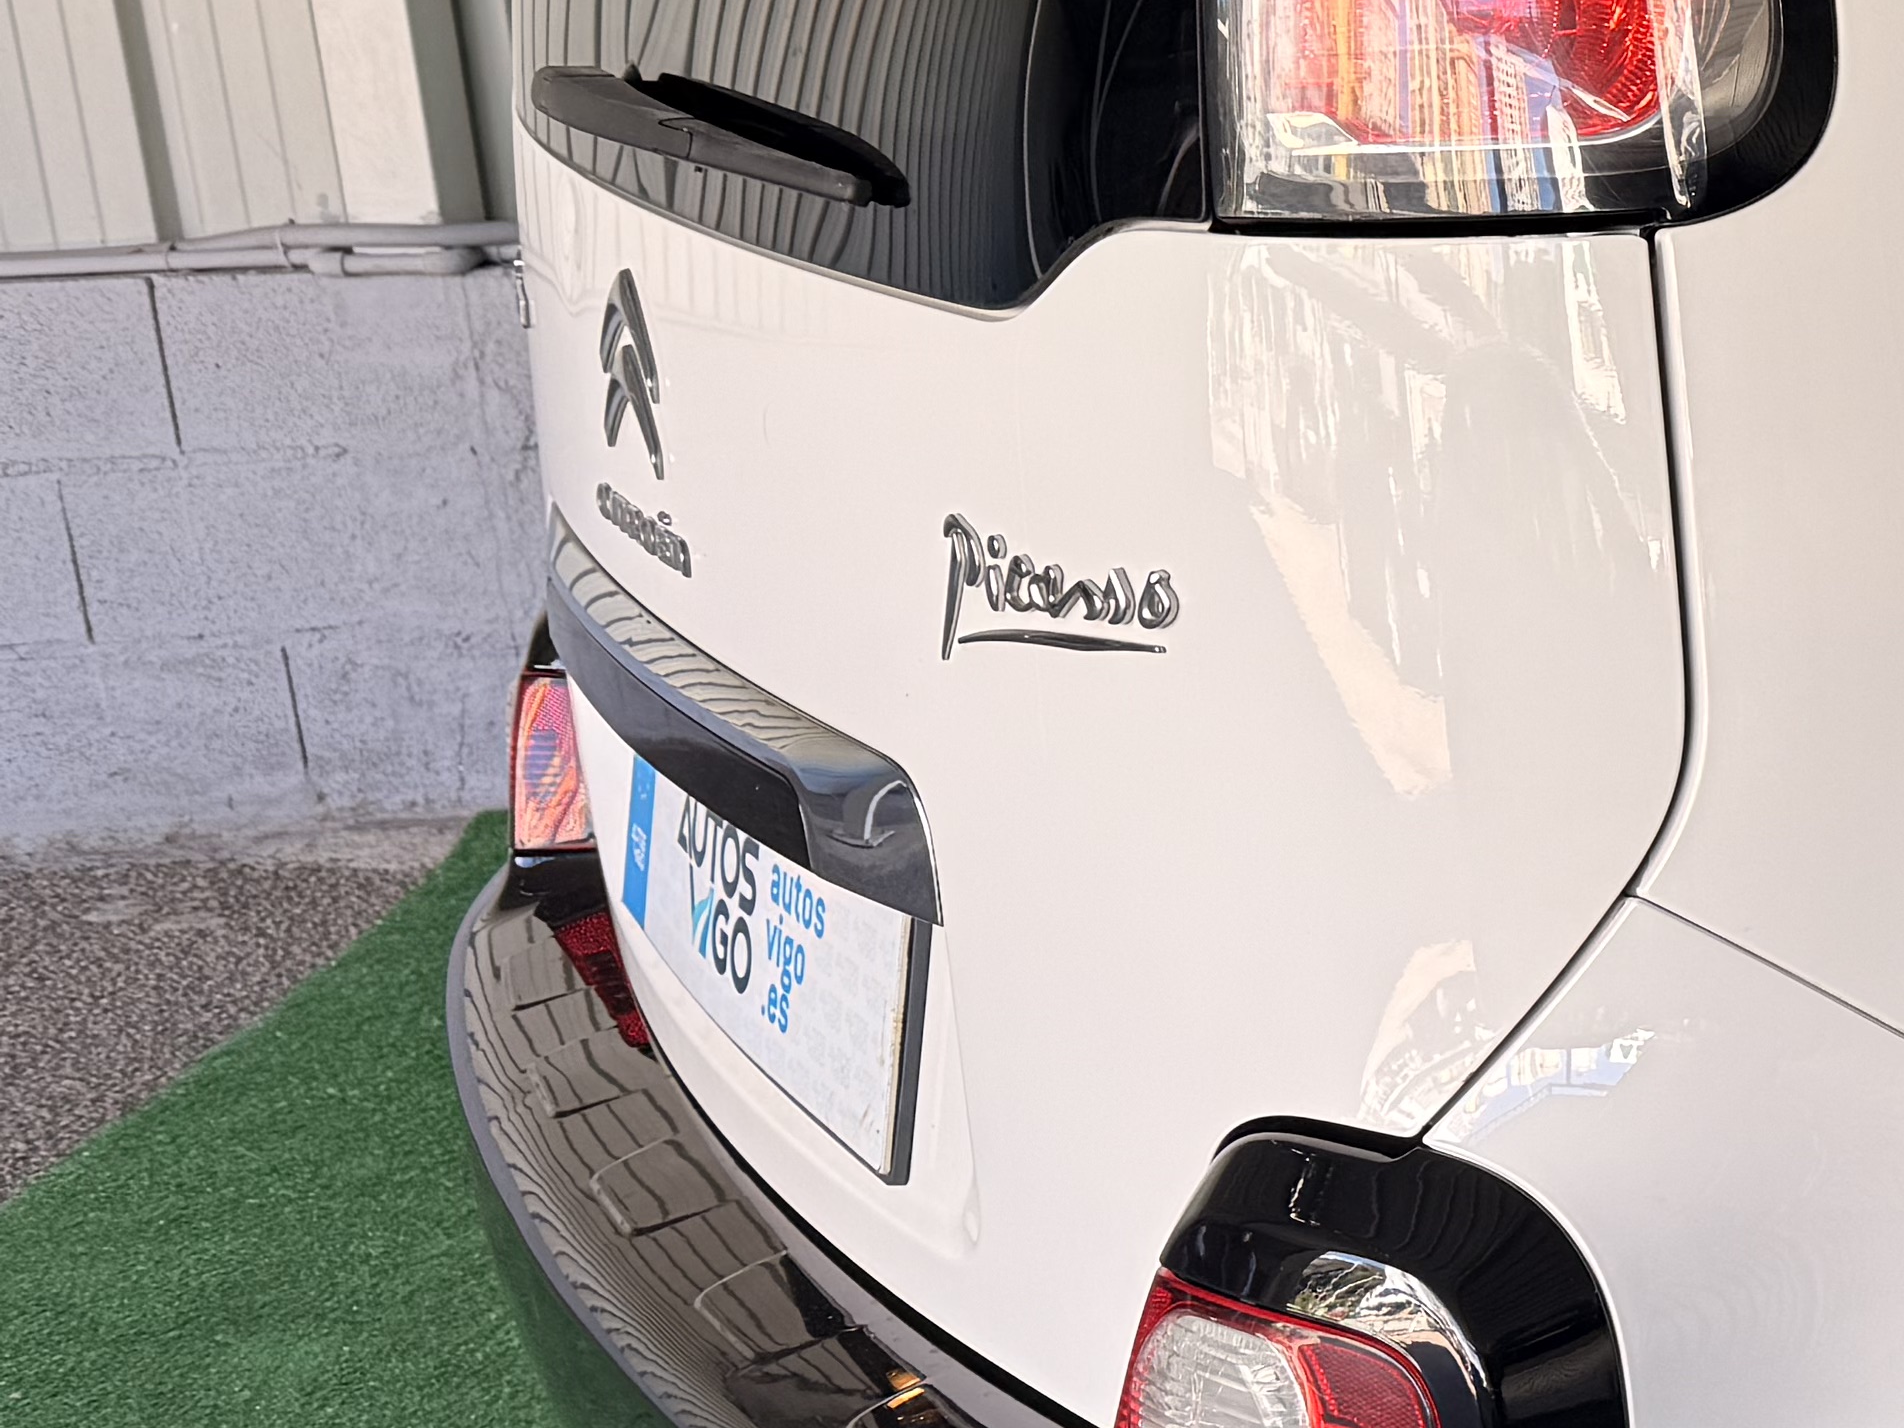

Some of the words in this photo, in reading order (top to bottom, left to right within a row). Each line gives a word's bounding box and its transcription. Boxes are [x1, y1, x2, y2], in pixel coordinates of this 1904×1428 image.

[942, 513, 1181, 660] Picasso
[677, 794, 760, 917] AUTOS
[770, 863, 826, 940] autos
[690, 860, 753, 995] VIGO
[766, 913, 806, 996] vigo
[761, 983, 789, 1034] .es
